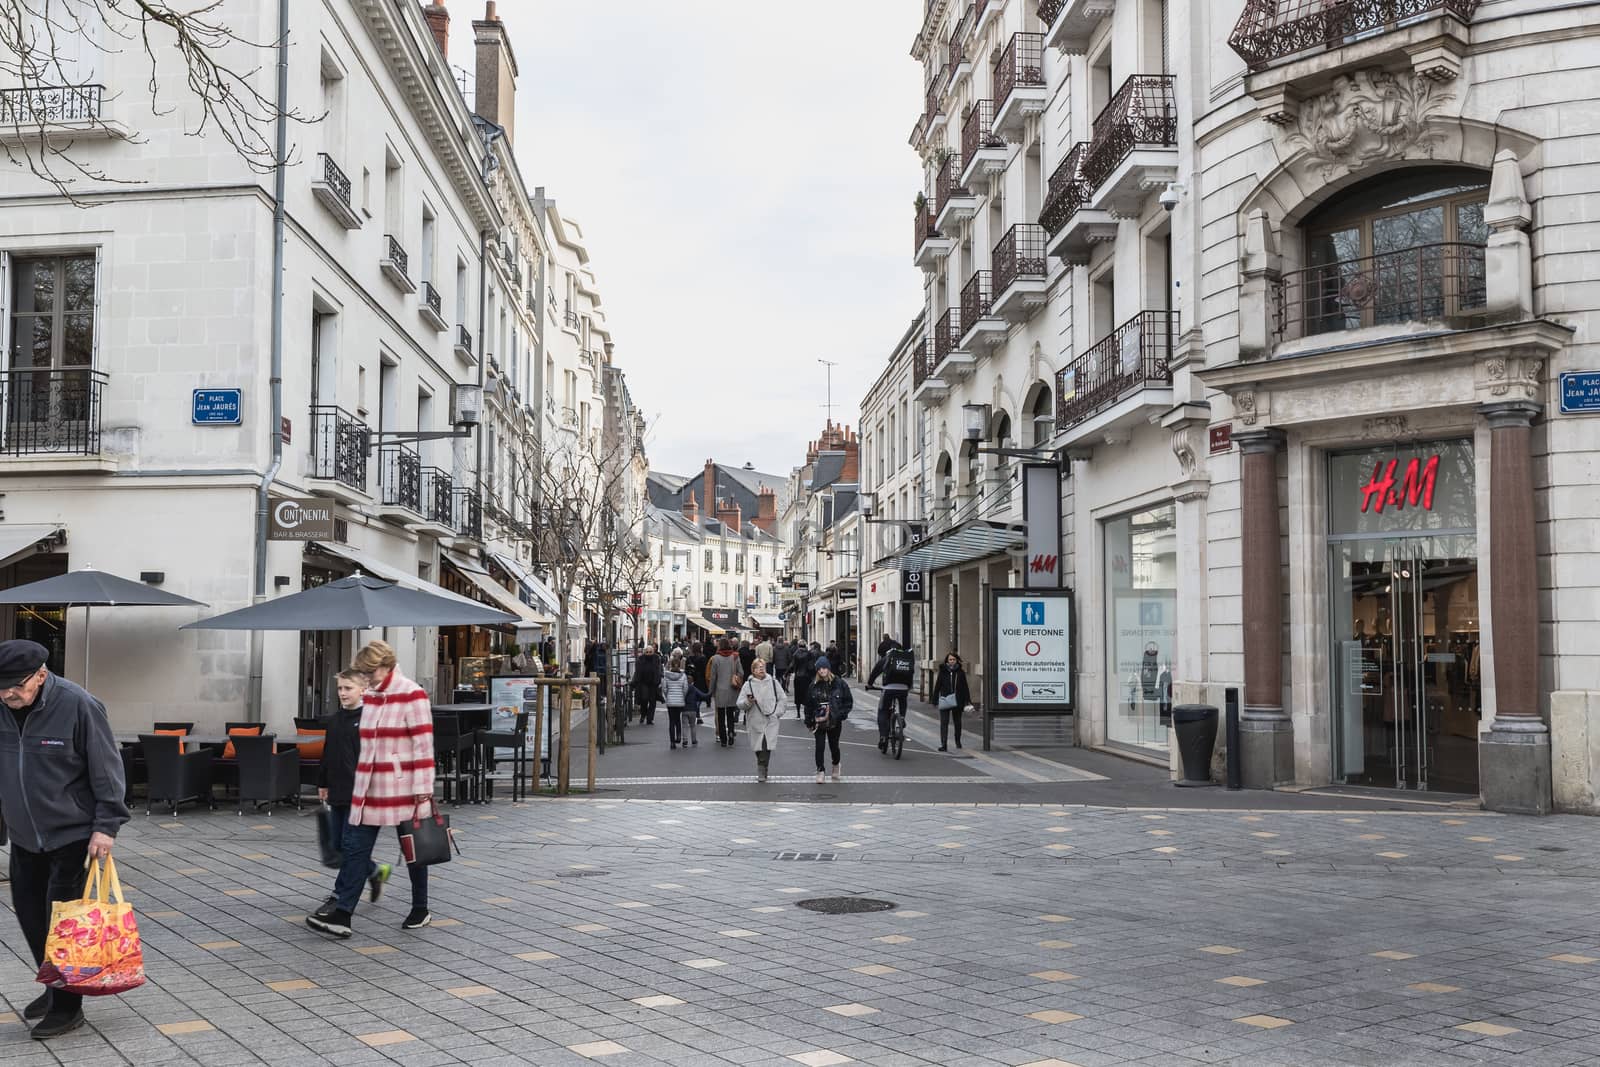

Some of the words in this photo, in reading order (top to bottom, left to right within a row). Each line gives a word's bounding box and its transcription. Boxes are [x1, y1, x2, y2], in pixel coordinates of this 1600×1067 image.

[197, 403, 211, 411] JEAN
[1360, 454, 1440, 514] H&M
[274, 500, 331, 529] CONTINENTAL
[1029, 554, 1058, 574] H&M
[1023, 628, 1065, 636] PIETONNE
